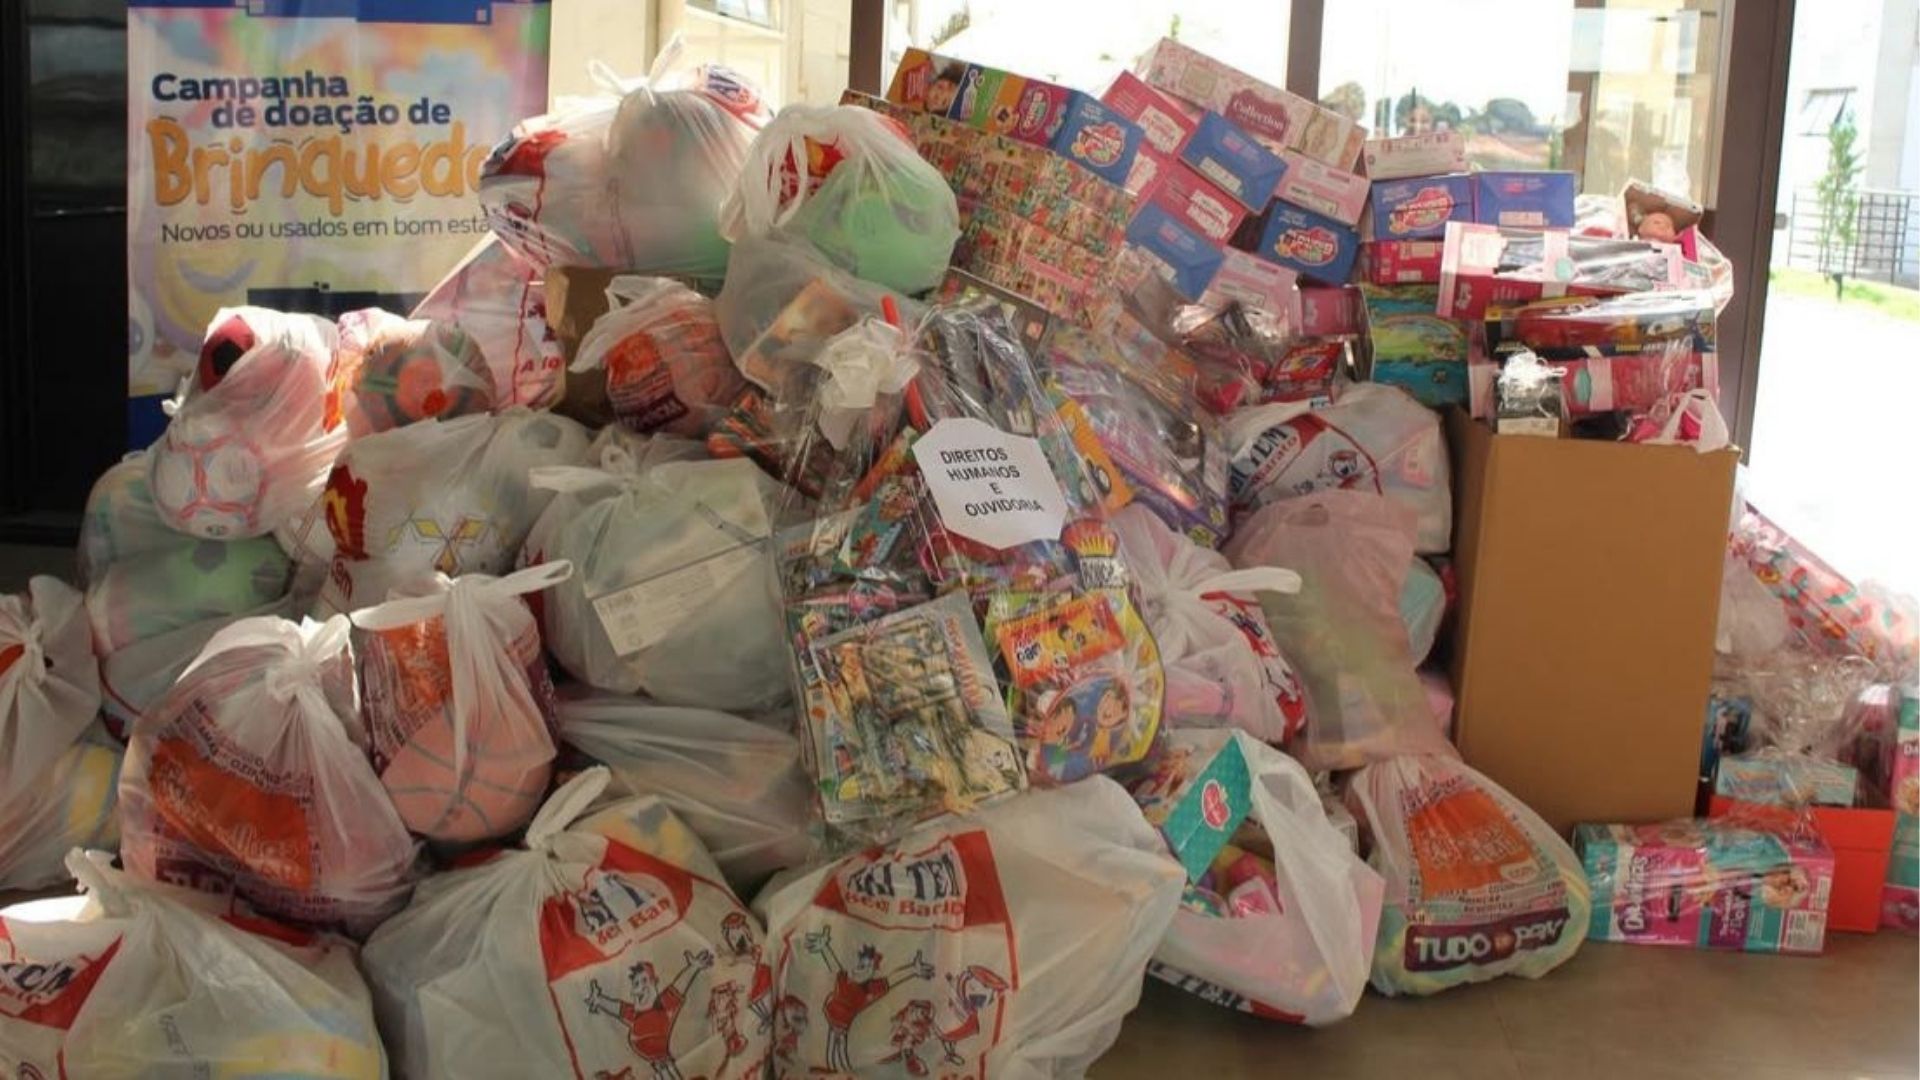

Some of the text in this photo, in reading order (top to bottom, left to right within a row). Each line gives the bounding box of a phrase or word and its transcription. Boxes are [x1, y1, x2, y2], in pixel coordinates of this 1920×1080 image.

[152, 70, 350, 103] Campanha
[211, 96, 452, 134] de doação de
[1233, 98, 1285, 130] Collection
[162, 220, 231, 243] Novos
[235, 221, 264, 240] ou
[269, 216, 348, 239] usados
[353, 217, 388, 237] em
[393, 215, 443, 236] bom
[940, 448, 1008, 465] DIREITOS
[946, 464, 1021, 482] HUMANOS
[989, 481, 1002, 495] E
[964, 499, 1046, 517] OUVIDORIA
[1412, 931, 1491, 963] TUDO
